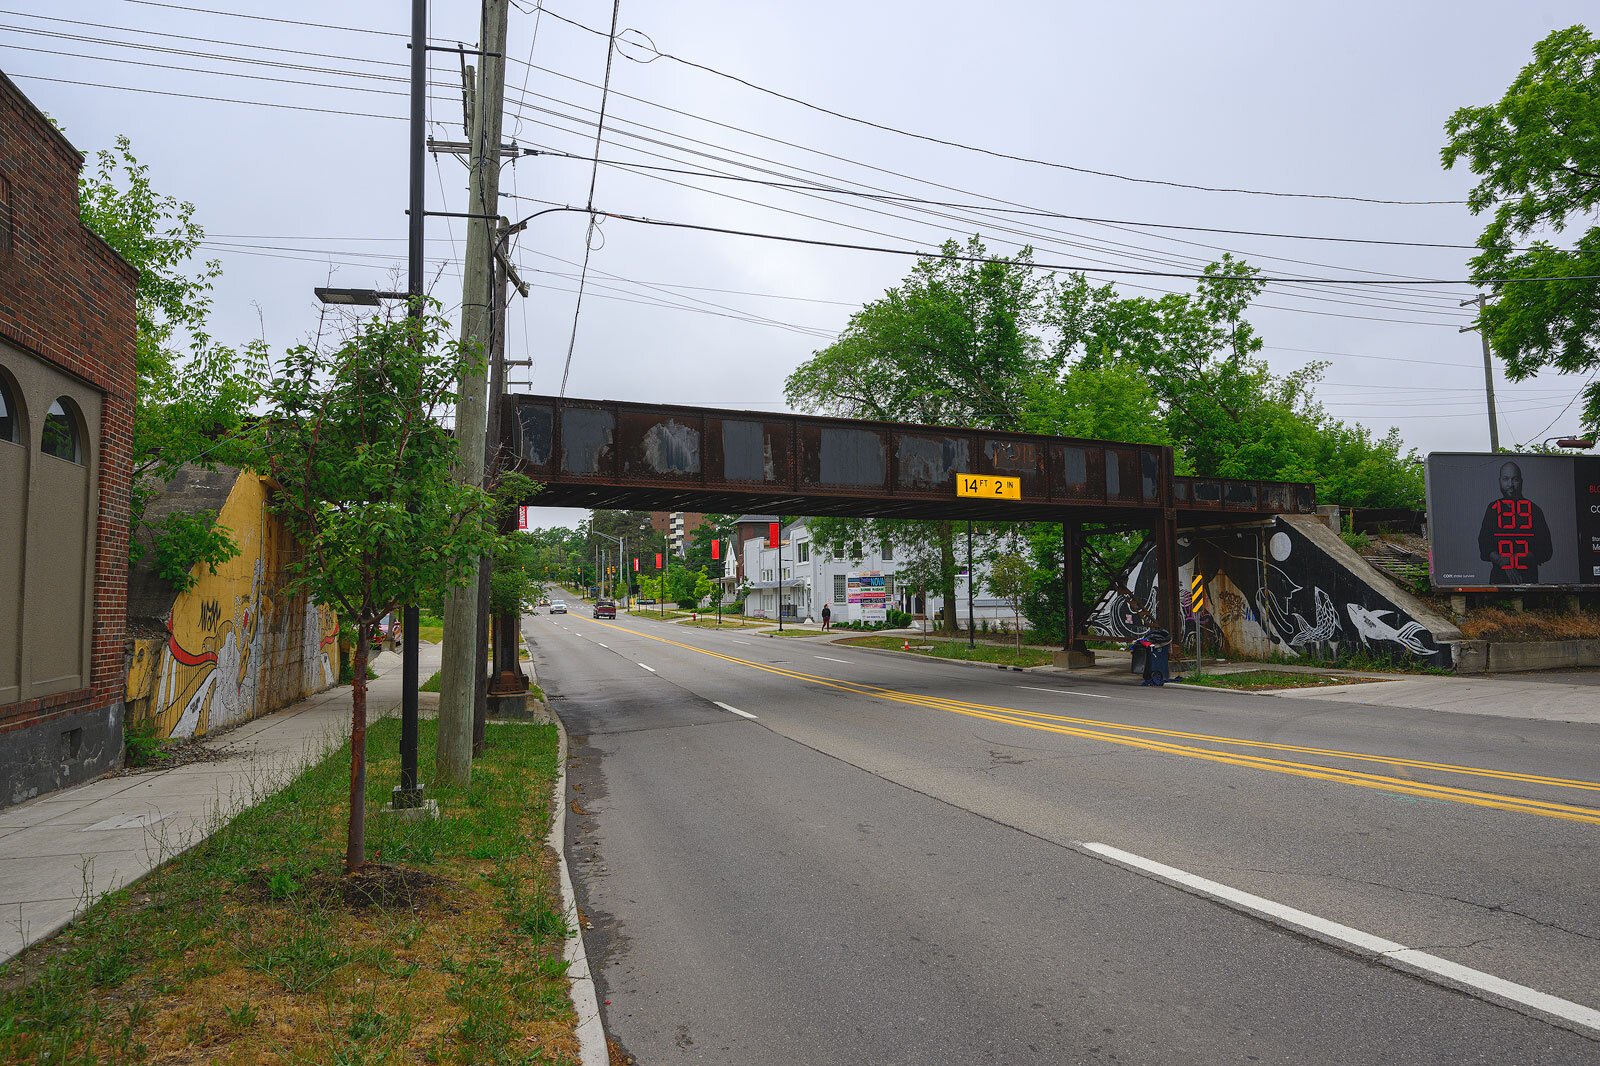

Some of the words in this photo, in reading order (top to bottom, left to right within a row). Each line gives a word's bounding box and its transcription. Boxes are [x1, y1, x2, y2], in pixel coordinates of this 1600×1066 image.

[964, 479, 978, 493] 14
[994, 480, 1003, 494] 2
[1006, 481, 1014, 489] IN
[1491, 499, 1533, 530] 139
[1497, 539, 1529, 570] 92
[870, 577, 885, 586] NOVA
